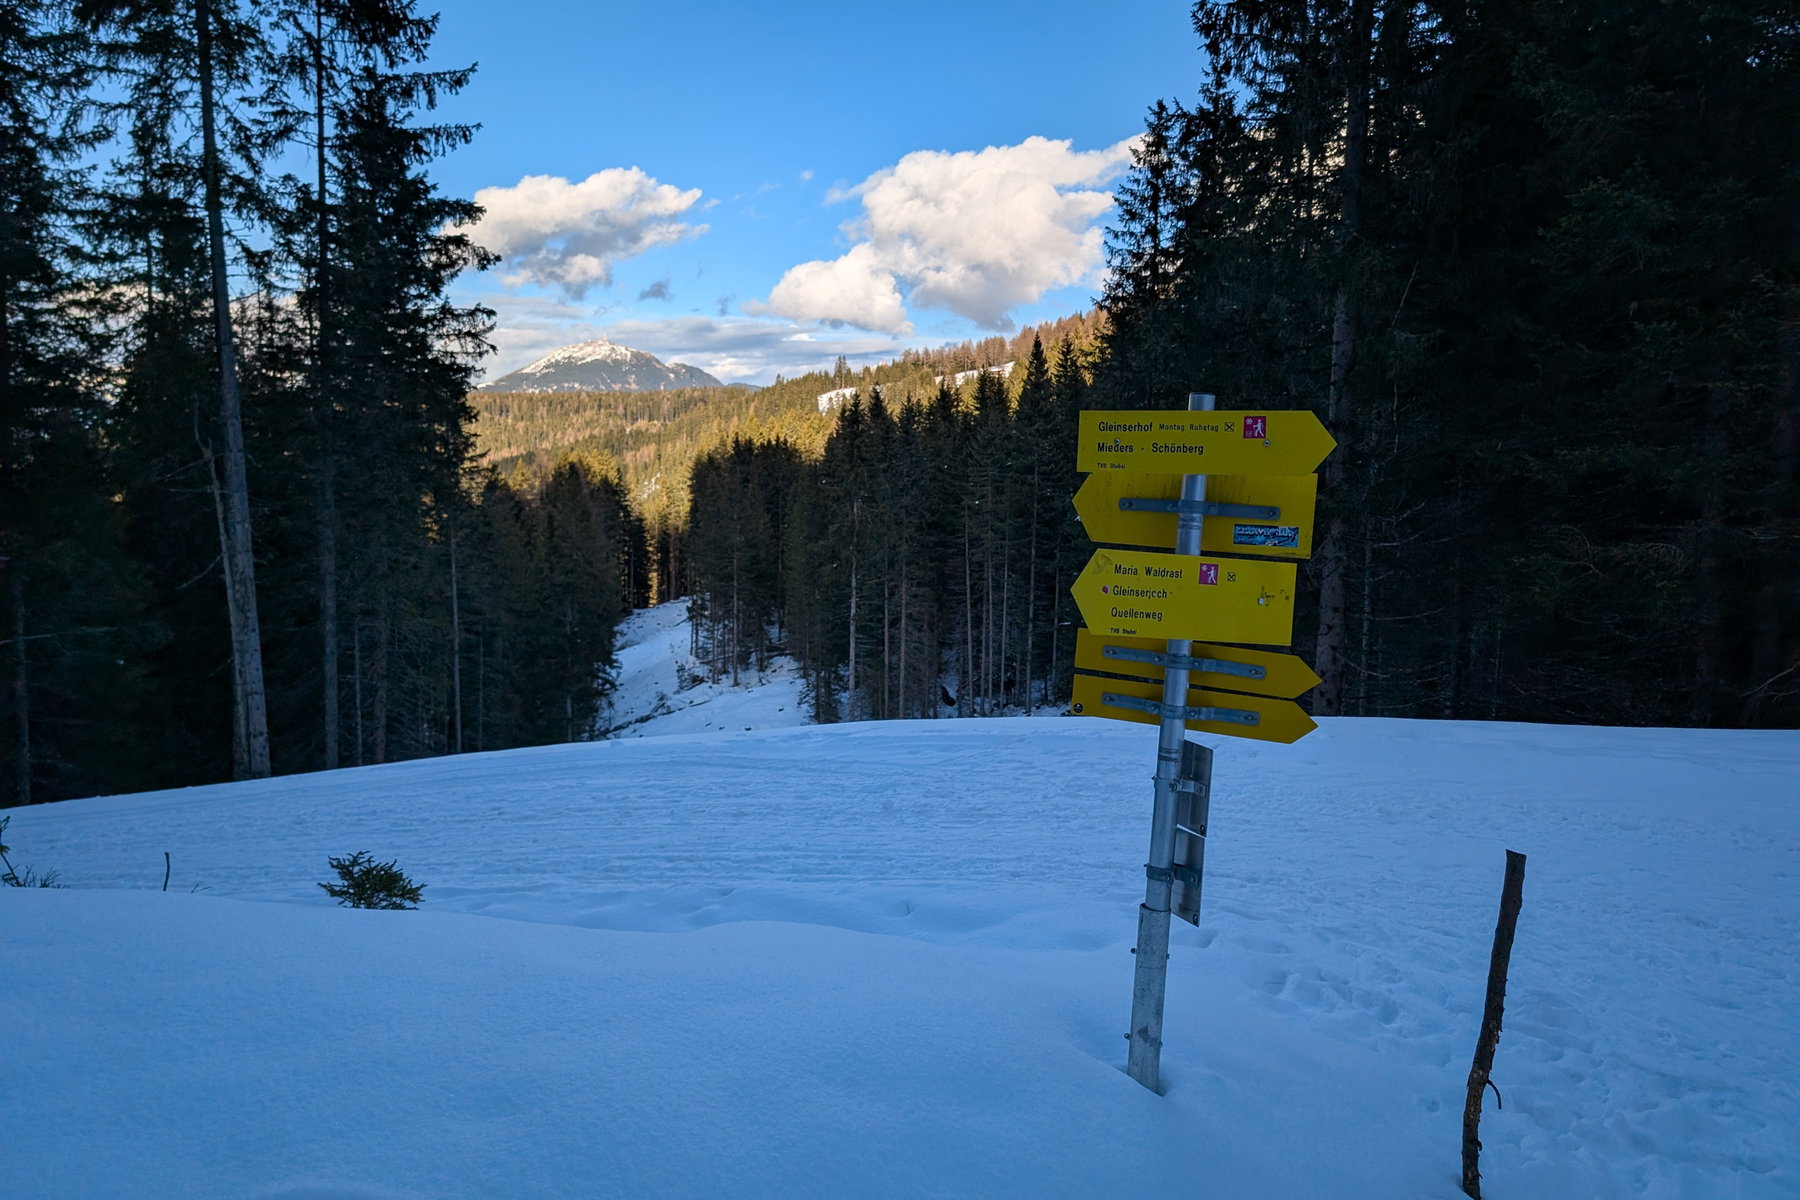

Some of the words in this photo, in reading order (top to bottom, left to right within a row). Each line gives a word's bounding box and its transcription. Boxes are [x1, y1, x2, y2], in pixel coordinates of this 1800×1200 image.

[1098, 421, 1153, 433] Gleinserhof
[1159, 423, 1185, 432] Montag
[1190, 423, 1219, 432] Ruhetag
[1097, 442, 1134, 453] Mieders
[1152, 442, 1204, 455] Schönberg
[1114, 564, 1138, 576] Maria
[1145, 566, 1183, 579] Waldrast
[1111, 607, 1163, 622] Quellenweg
